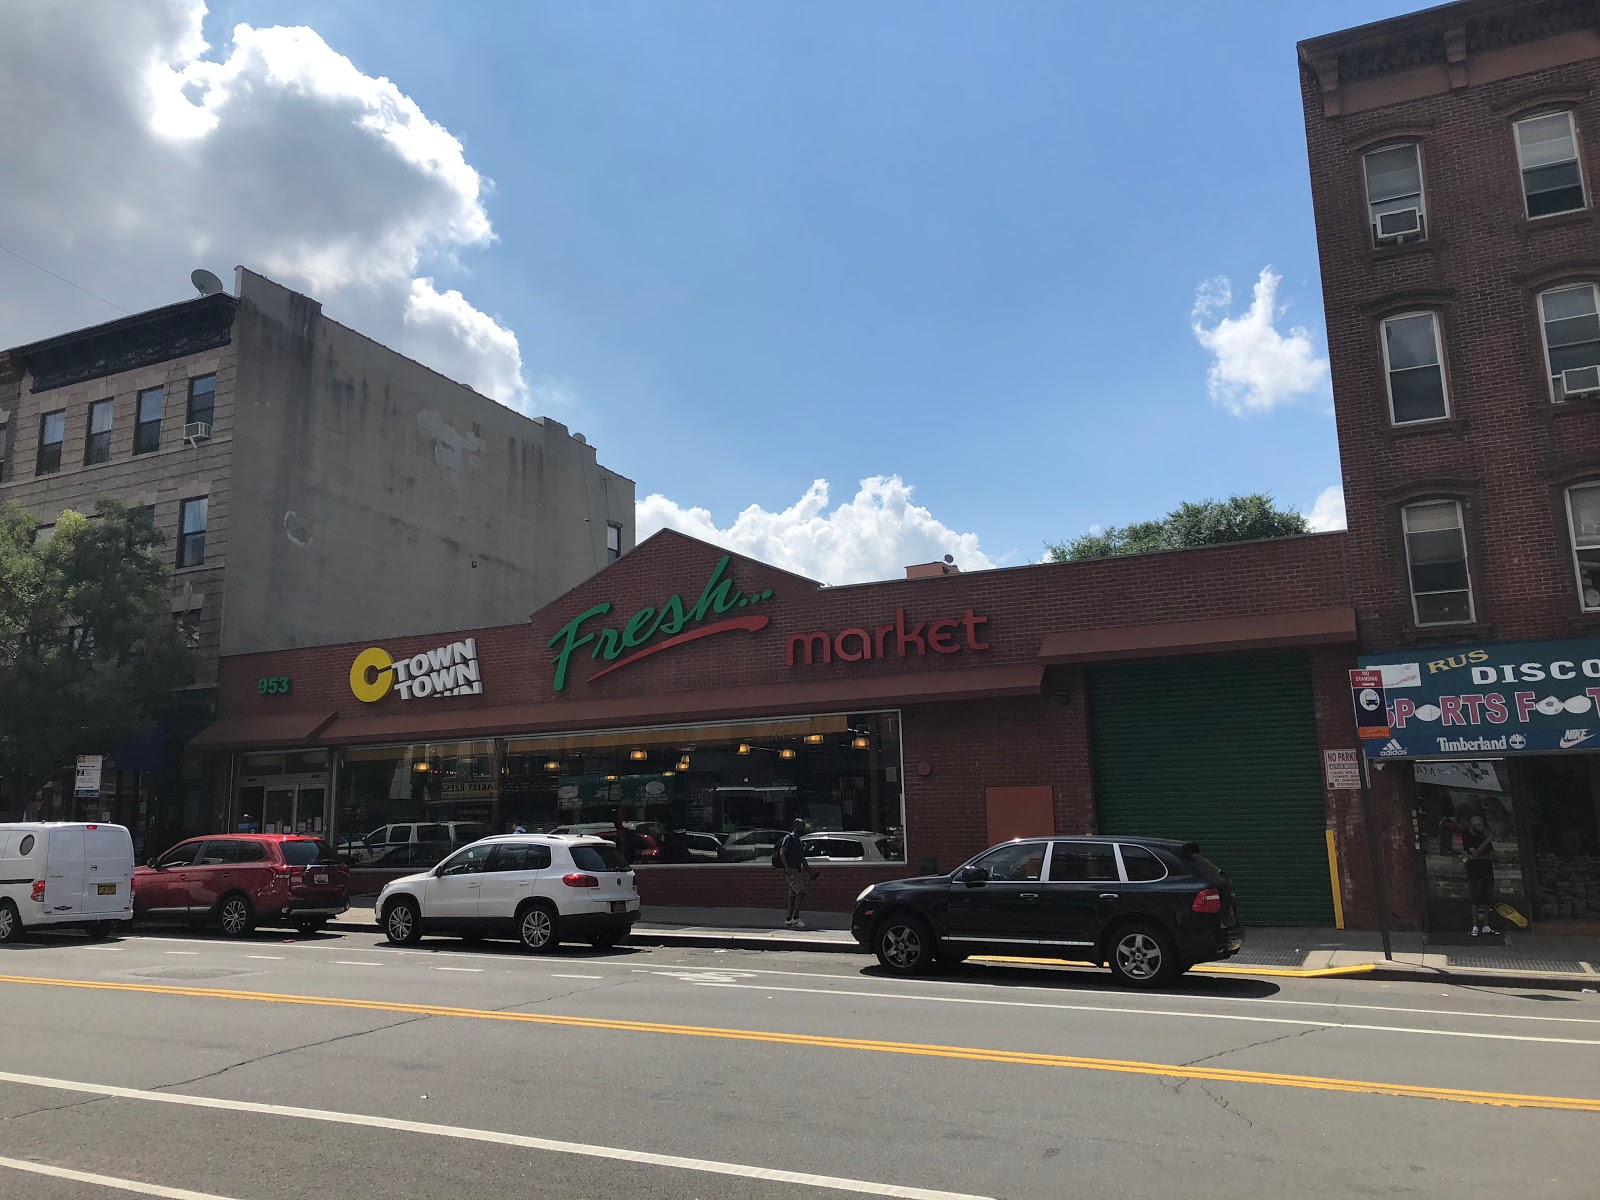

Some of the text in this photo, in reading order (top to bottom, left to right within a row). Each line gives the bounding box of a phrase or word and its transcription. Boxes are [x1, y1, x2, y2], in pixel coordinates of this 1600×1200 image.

[785, 609, 990, 666] market
[392, 638, 478, 682] TOWN
[1427, 649, 1489, 674] RUS
[258, 677, 290, 695] 953
[394, 660, 481, 700] TOWN
[1328, 752, 1357, 762] NO PARKI
[1379, 728, 1589, 757] adidas Timberland NIKE
